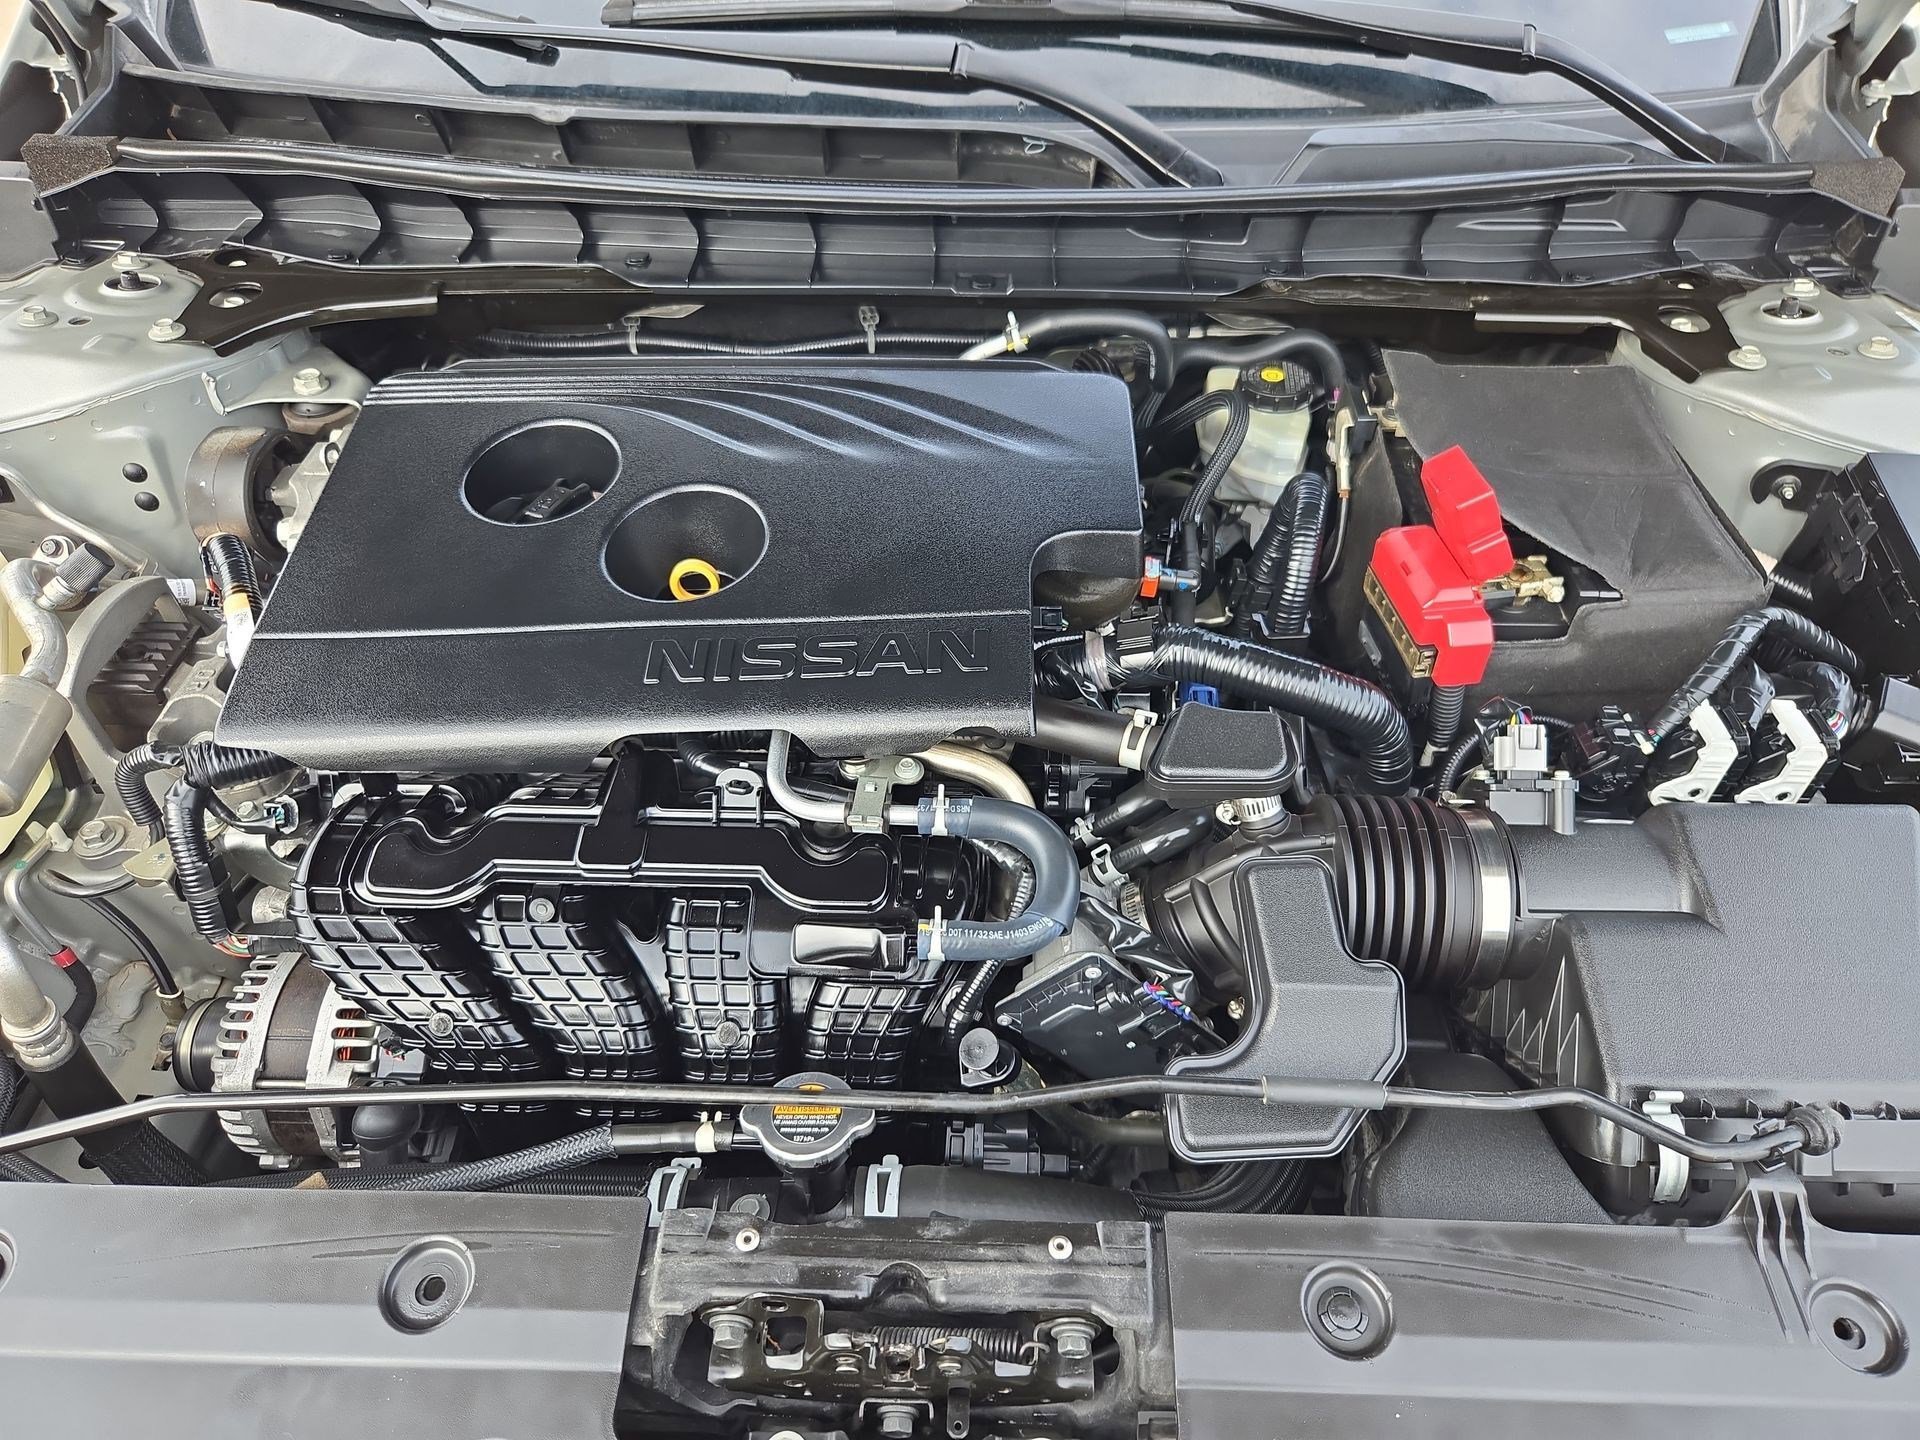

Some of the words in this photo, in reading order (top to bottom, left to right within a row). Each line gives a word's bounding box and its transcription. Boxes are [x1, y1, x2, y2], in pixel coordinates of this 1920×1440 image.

[643, 629, 990, 684] NISSAN
[948, 928, 962, 938] DOT
[964, 930, 988, 939] 11/32
[988, 930, 1003, 940] SAE
[1004, 927, 1029, 939] J1403
